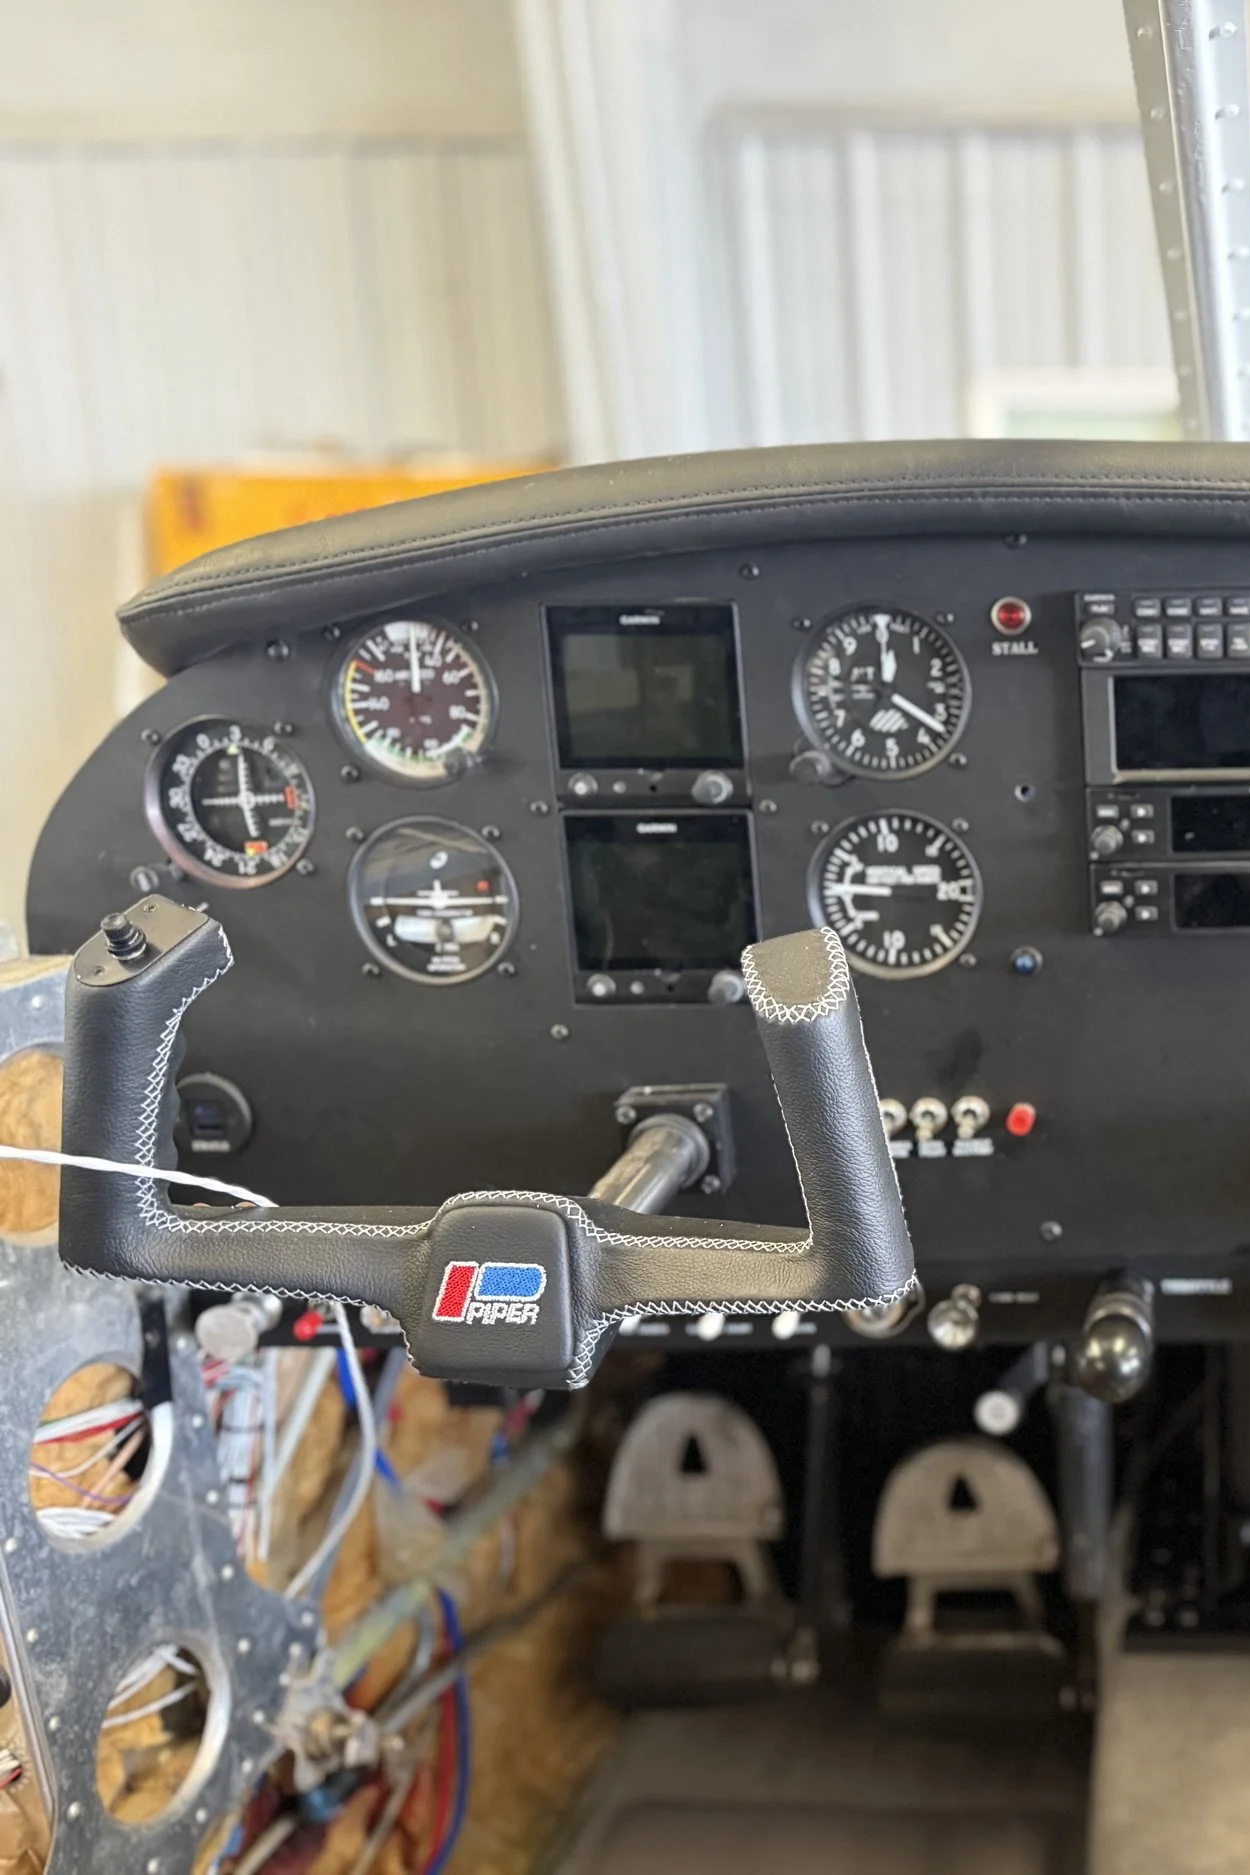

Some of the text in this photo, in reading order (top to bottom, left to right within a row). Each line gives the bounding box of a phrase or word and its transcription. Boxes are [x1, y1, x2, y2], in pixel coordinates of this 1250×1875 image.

[991, 640, 1039, 656] STALL
[930, 657, 944, 678] 2
[833, 709, 847, 729] 7
[851, 728, 867, 748] 6
[884, 738, 900, 758] 5
[876, 833, 899, 853] 10
[937, 881, 959, 900] 20
[882, 930, 906, 950] 10
[466, 1301, 540, 1325] PIPER
